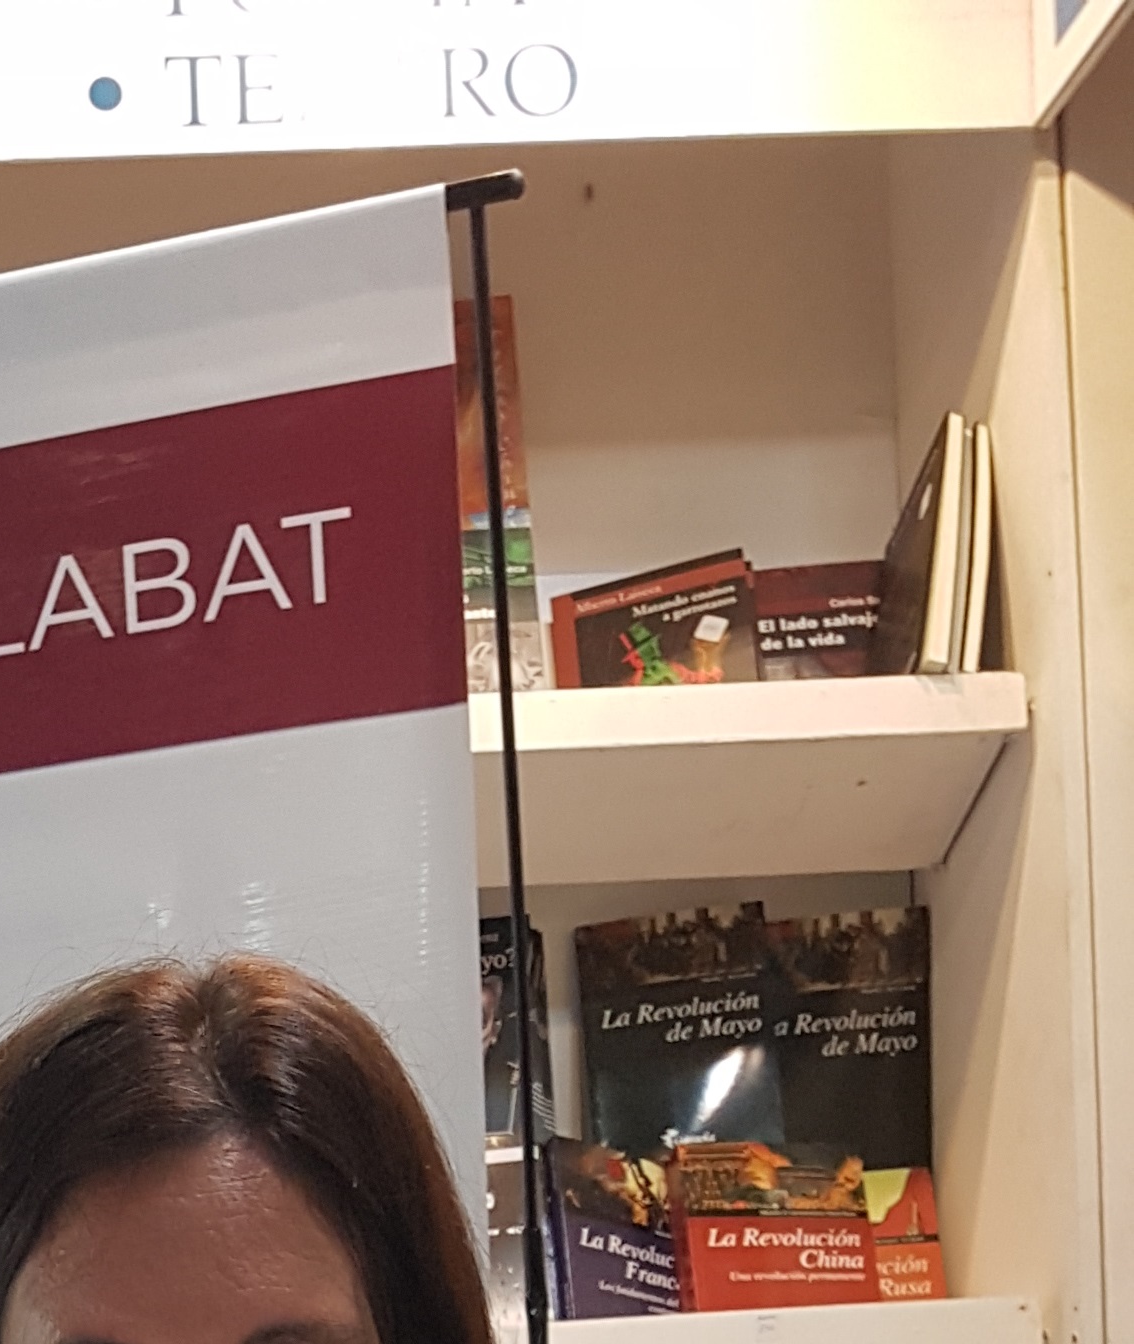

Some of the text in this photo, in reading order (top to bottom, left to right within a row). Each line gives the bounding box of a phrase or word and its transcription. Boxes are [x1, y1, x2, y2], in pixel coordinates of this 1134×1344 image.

[165, 44, 578, 127] TERO
[757, 619, 776, 633] El
[779, 616, 819, 631] lado
[760, 632, 846, 651] de la vida
[601, 991, 760, 1030] La Revolución
[774, 1005, 916, 1037] a Revolución
[666, 1016, 763, 1043] de Mayo
[822, 1032, 918, 1057] de Mayo
[579, 1226, 675, 1269] La Revoluc
[707, 1227, 736, 1247] La
[742, 1226, 861, 1247] Revolución
[799, 1249, 865, 1269] China
[625, 1260, 680, 1290] Franc
[729, 1271, 752, 1282] Una
[879, 1278, 933, 1296] Rusa
